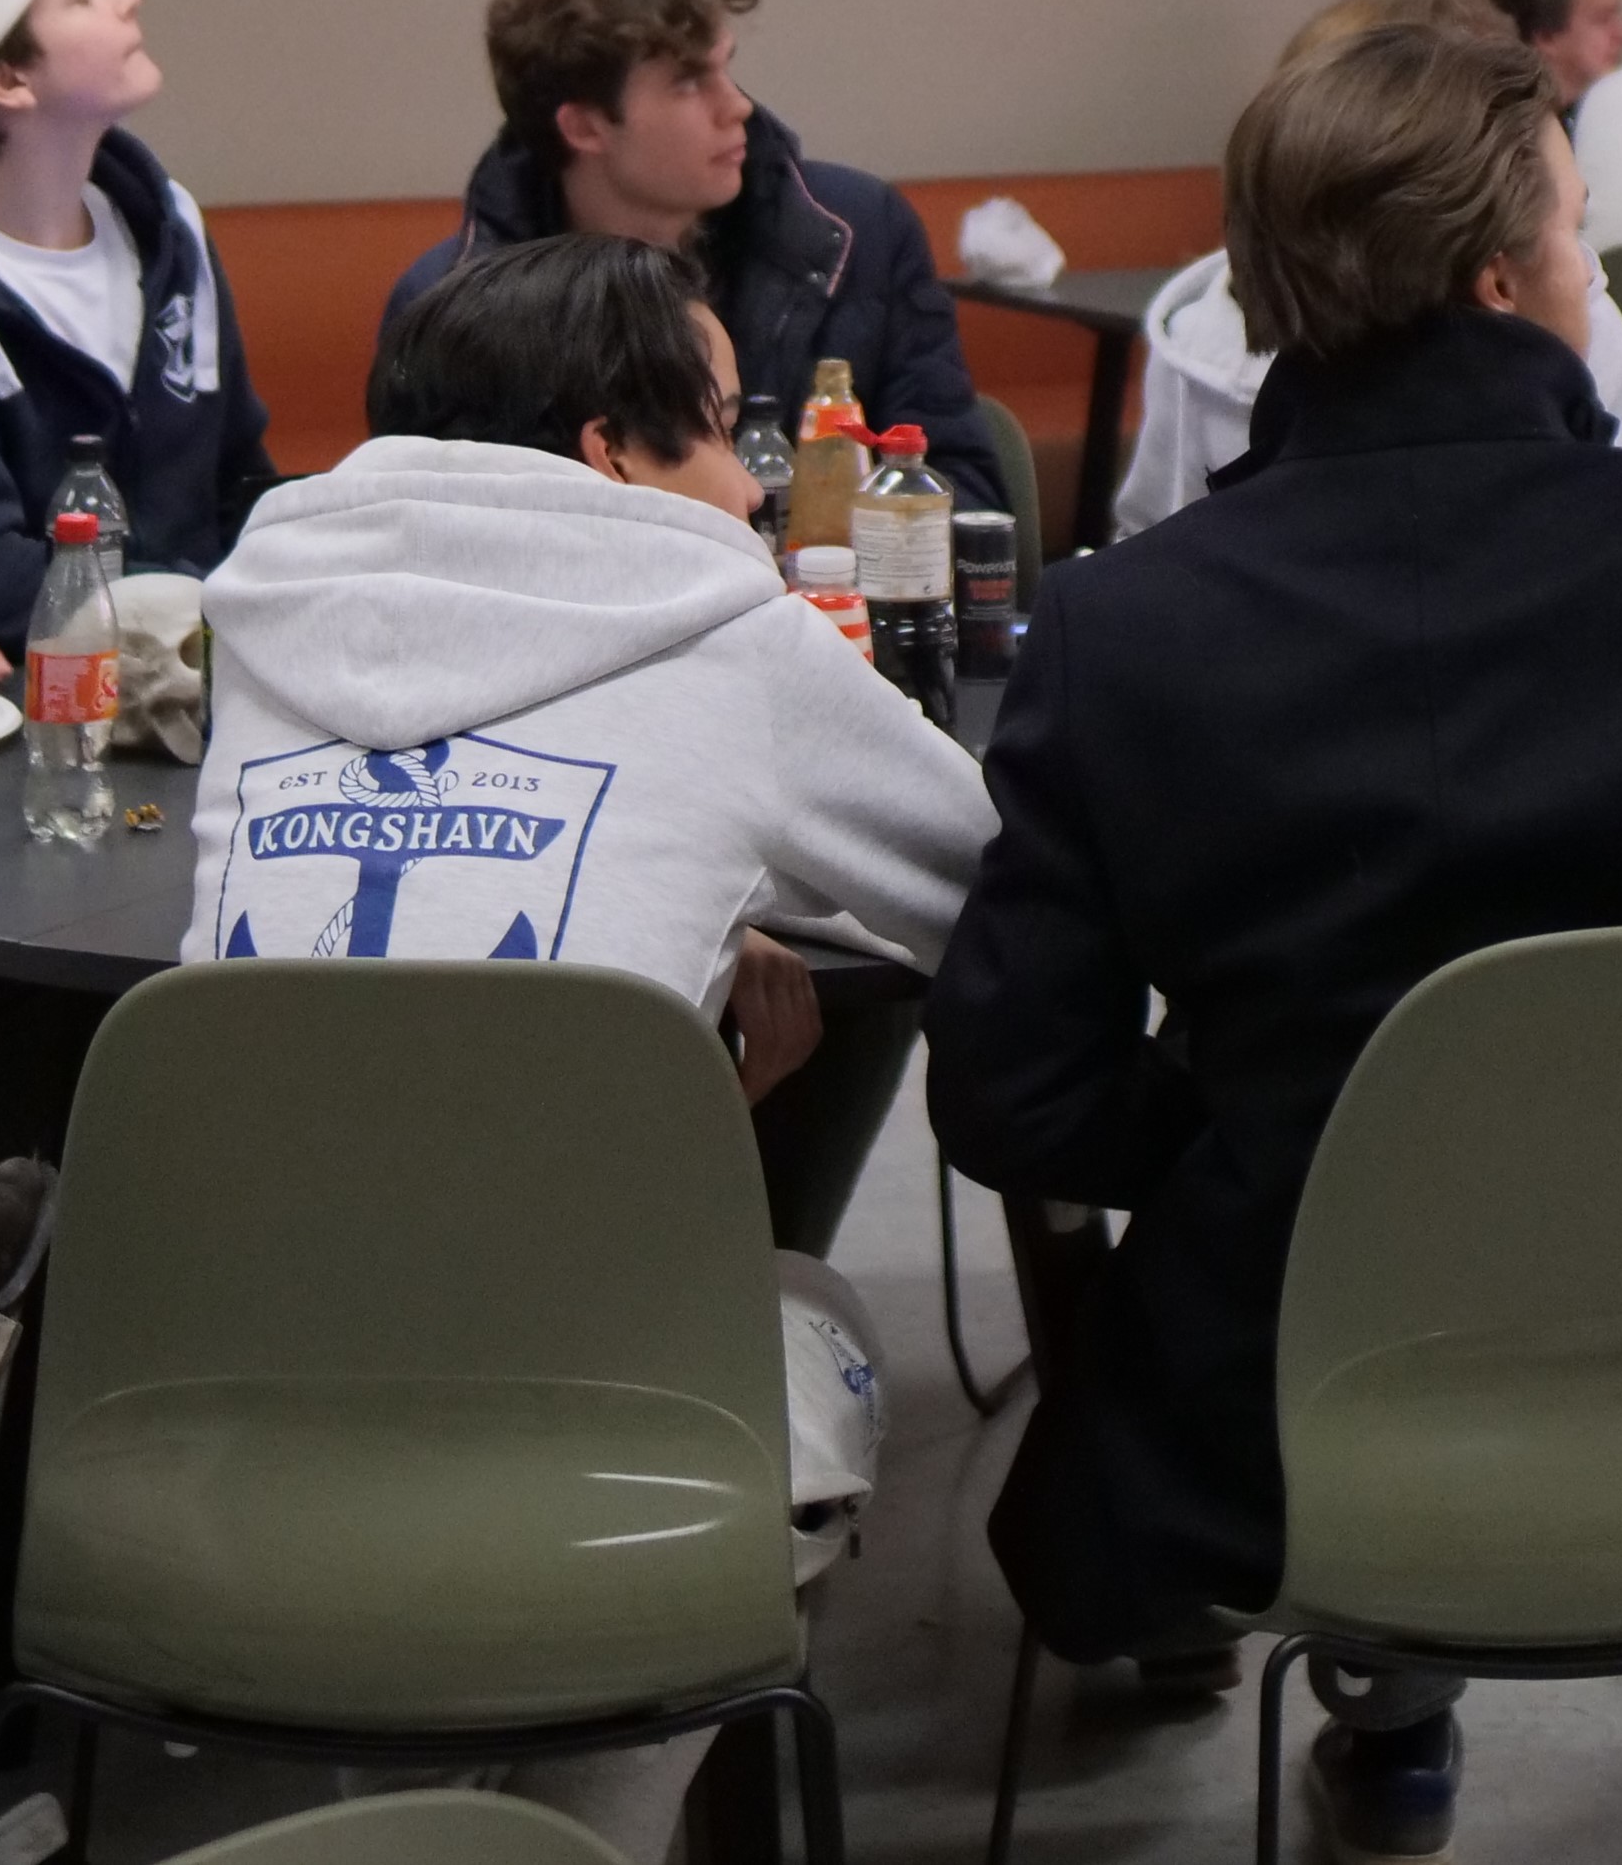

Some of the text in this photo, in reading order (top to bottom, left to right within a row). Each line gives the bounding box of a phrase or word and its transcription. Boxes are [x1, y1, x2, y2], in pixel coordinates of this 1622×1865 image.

[277, 770, 543, 793] EST 2013
[254, 810, 540, 855] KONGSHAVN
